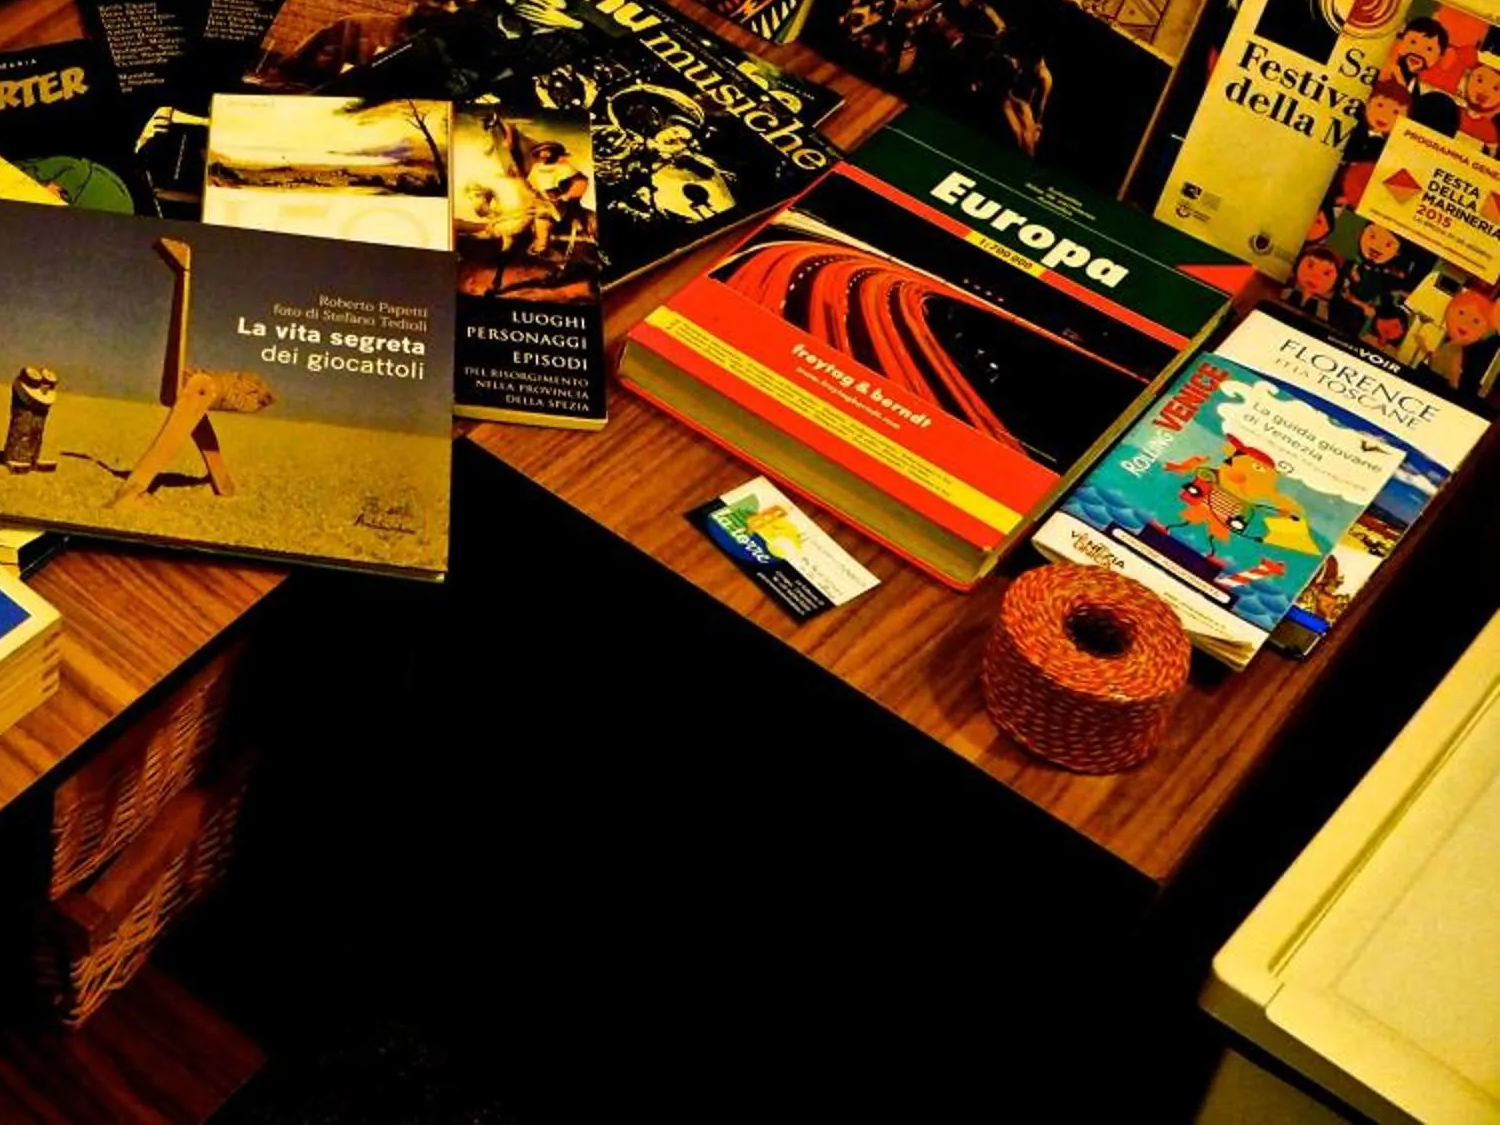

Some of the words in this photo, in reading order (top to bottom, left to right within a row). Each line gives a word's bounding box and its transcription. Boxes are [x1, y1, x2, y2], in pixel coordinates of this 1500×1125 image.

[1236, 42, 1366, 118] Festiva
[640, 30, 826, 170] musiche
[1225, 78, 1312, 136] della
[1427, 181, 1477, 211] DELLA
[1432, 168, 1481, 199] FESTA
[930, 171, 1129, 288] Europa
[1416, 205, 1453, 227] 2015
[1421, 192, 1500, 240] MARINERIA
[273, 304, 300, 317] foto
[306, 309, 318, 319] di
[323, 310, 375, 325] Stefano
[320, 294, 374, 312] Roberto
[512, 311, 585, 329] LUOGHI
[237, 316, 266, 336] La
[276, 323, 320, 343] vita
[330, 332, 425, 355] segreta
[467, 326, 587, 349] PERSONAGGI
[261, 345, 299, 364] dei
[308, 351, 424, 380] giocattoli
[513, 351, 587, 371] EPISODI
[1279, 338, 1442, 419] FLORENCE
[506, 395, 544, 406] DELLA
[855, 380, 870, 394] &
[1152, 363, 1229, 432] VENICE
[1317, 374, 1421, 429] TOSCANE
[1243, 413, 1260, 426] di
[1263, 423, 1324, 462] Venezia
[1252, 402, 1270, 415] La
[1273, 413, 1317, 443] guida
[1318, 436, 1382, 474] giovane
